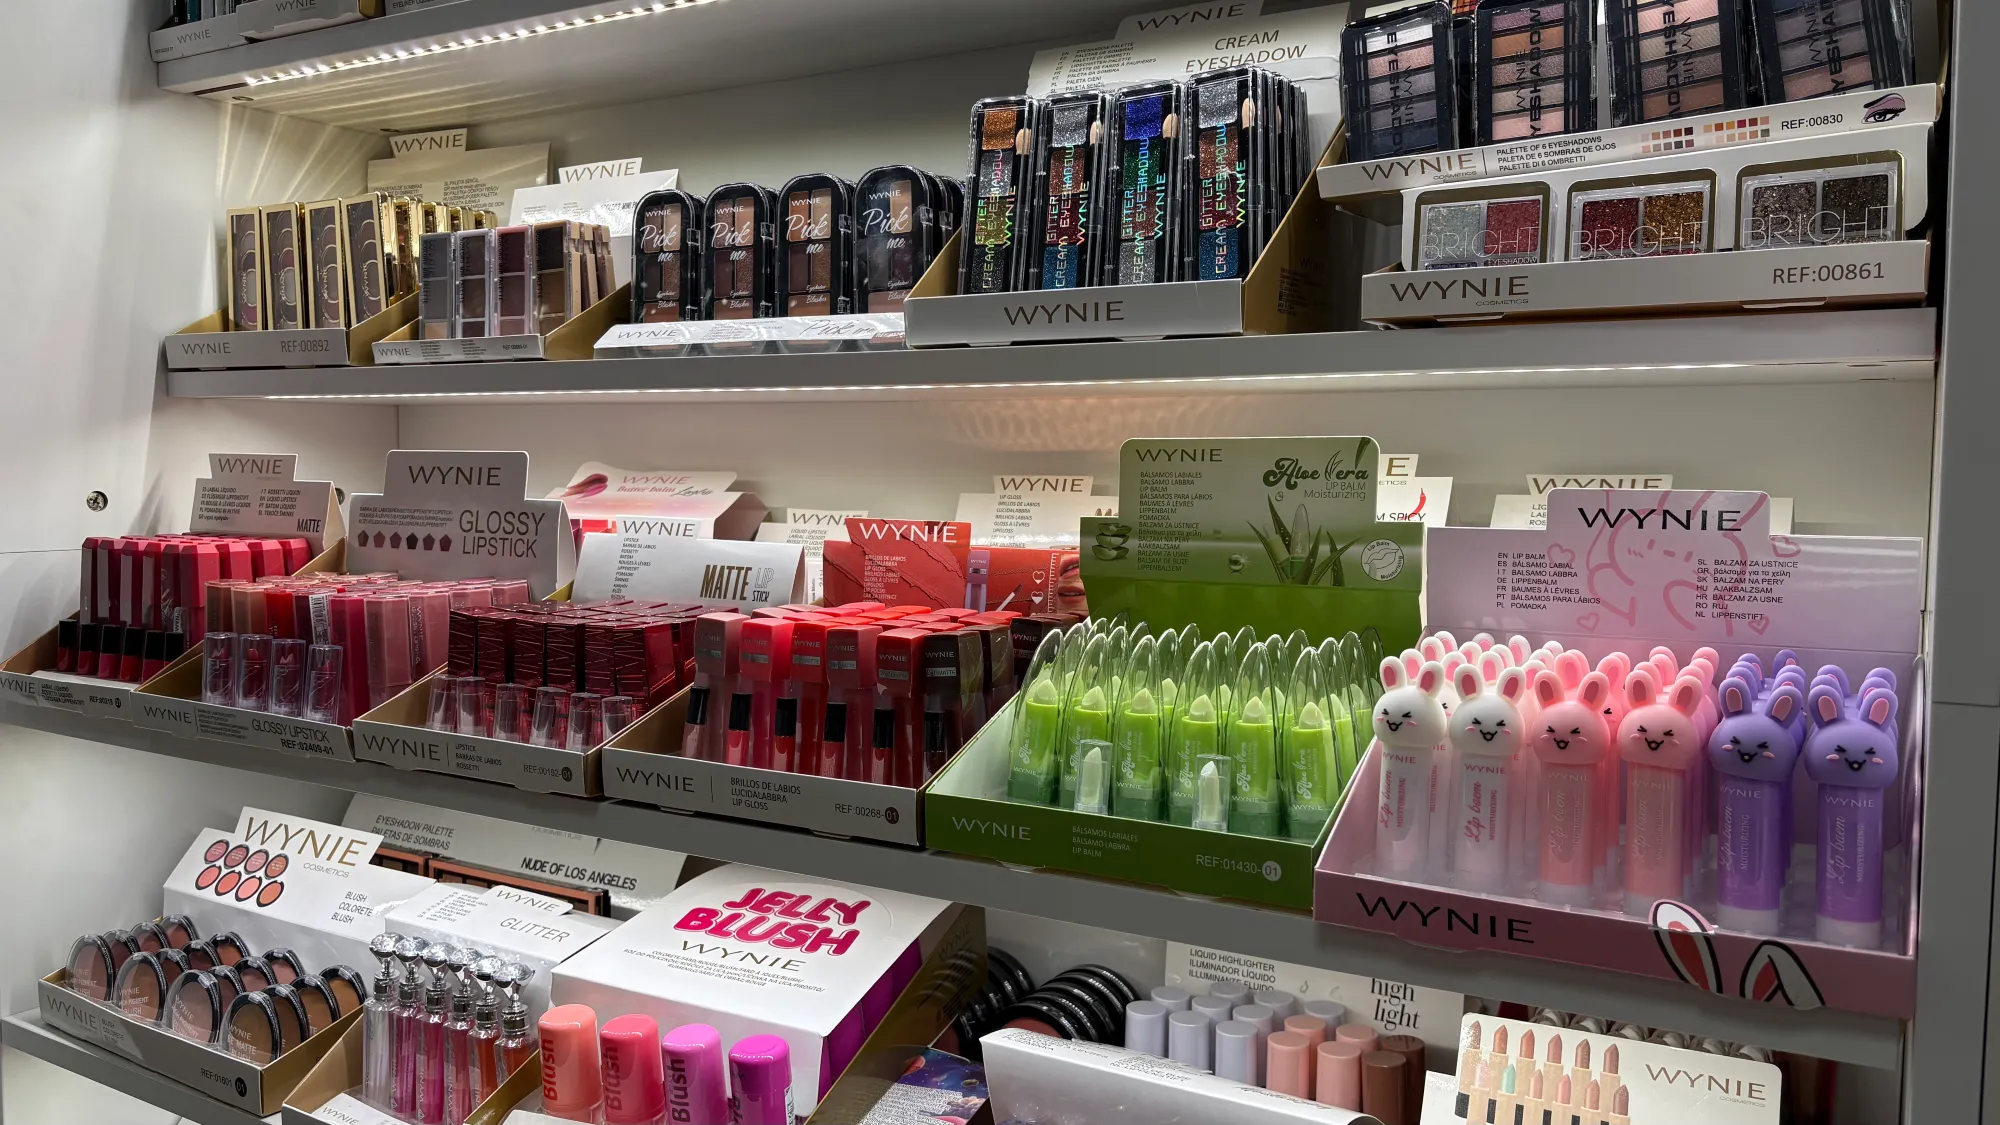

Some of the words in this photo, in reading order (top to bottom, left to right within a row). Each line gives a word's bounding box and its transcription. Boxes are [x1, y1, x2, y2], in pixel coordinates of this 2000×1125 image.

[1137, 3, 1246, 31] WYNIE
[177, 29, 211, 44] WYNIE
[1214, 30, 1280, 51] CREAM
[1185, 45, 1307, 74] EYESHADOW
[1516, 49, 1527, 111] WYNIE
[1781, 114, 1843, 130] REF:00830
[394, 133, 464, 153] WYNIE
[1496, 146, 1529, 155] PALETTE
[1530, 144, 1540, 152] OF
[1548, 136, 1602, 149] EYESHADOWS
[1497, 154, 1524, 163] PALETA
[1526, 152, 1536, 161] DE
[1544, 147, 1581, 158] SOMBRAS
[1583, 146, 1594, 154] DE
[1595, 142, 1617, 152] OJOS
[565, 161, 637, 183] WYNIE
[1216, 122, 1227, 211] EYESHADOW
[1361, 153, 1476, 180] WYNIE
[1499, 162, 1531, 172] PALETTE
[1532, 160, 1540, 168] DI
[1547, 156, 1586, 166] OMBRETTI
[988, 150, 1003, 230] EYESHADOW
[1060, 144, 1075, 228] EYESHADOW
[1136, 137, 1149, 222] EYESHADOW
[791, 197, 821, 206] WYNIE
[869, 189, 901, 200] WYNIE
[1236, 159, 1246, 228] WYNIE
[645, 209, 672, 217] WYNIE
[716, 206, 745, 215] WYNIE
[1003, 185, 1016, 249] WYNIE
[1076, 181, 1089, 246] WYNIE
[1154, 173, 1166, 239] WYNIE
[785, 213, 827, 240] Pick
[863, 206, 909, 236] Pick
[1742, 205, 1895, 248] BRIGHT
[640, 224, 677, 249] Pick
[710, 221, 751, 248] Pick
[886, 237, 906, 249] me
[1421, 227, 1539, 261] BRIGHT
[1571, 221, 1707, 260] BRIGHT
[657, 252, 674, 262] me
[729, 251, 747, 261] me
[806, 243, 824, 254] me
[1133, 231, 1145, 283] CREAM
[1215, 219, 1227, 274] CREAM
[982, 239, 995, 289] CREAM
[1055, 236, 1068, 287] CREAM
[1773, 262, 1885, 284] REF:00861
[1390, 276, 1529, 301] WYNIE
[1004, 301, 1124, 326] WYNIE
[618, 329, 679, 340] WYNIE
[182, 342, 231, 355] WYNIE
[280, 340, 329, 353] REF:00892
[378, 347, 411, 357] WYNIE
[218, 458, 283, 474] WYNIE
[1136, 448, 1222, 462] WYNIE
[409, 465, 501, 486] WYNIE
[623, 475, 692, 485] WYNIE
[1262, 457, 1320, 491] Aloe
[1324, 450, 1369, 481] Vera
[1000, 477, 1084, 492] WYNIE
[1303, 489, 1366, 502] Moisturizing
[1326, 482, 1338, 491] LIP
[1340, 482, 1366, 491] BALM
[297, 518, 321, 533] MATTE
[459, 510, 546, 537] GLOSSY
[623, 520, 696, 537] WYNIE
[1578, 506, 1742, 532] WYNIE
[859, 522, 957, 543] WYNIE
[462, 536, 537, 559] LIPSTICK
[1512, 560, 1548, 569] BÁLSAMO
[1714, 559, 1747, 567] BALZAM
[1761, 561, 1799, 569] USTNICE
[700, 564, 753, 601] MATTE
[755, 567, 775, 589] LIP
[1511, 578, 1558, 586] LIPPENBALM
[1713, 586, 1773, 594] AJAKBALZSAM
[752, 589, 770, 603] STICK
[1511, 594, 1551, 602] BÁLSAMOS
[1573, 596, 1601, 604] LÁBIOS
[1747, 595, 1759, 603] ZA
[1760, 596, 1784, 604] USNE
[1711, 612, 1764, 620] LIPPENSTIFT
[794, 639, 820, 648] WYNIE
[879, 654, 908, 662] WYNIE
[143, 704, 192, 724] WYNIE
[251, 718, 286, 738] GLOSSY
[287, 724, 330, 744] LIPSTICK
[362, 733, 441, 762] WYNIE
[455, 743, 477, 752] LIPSTICK
[456, 762, 480, 772] ROSSETTI
[1464, 762, 1506, 775] WYNIE
[616, 766, 696, 793] WYNIE
[730, 777, 760, 790] BRILLOS
[761, 781, 772, 790] DE
[773, 781, 801, 794] LABIOS
[731, 787, 788, 803] LUCIDALABBRA
[1232, 795, 1260, 804] WYNIE
[1720, 785, 1762, 799] WYNIE
[1825, 795, 1875, 808] WYNIE
[732, 799, 743, 807] LIP
[744, 800, 769, 811] GLOSS
[1489, 789, 1498, 841] MOISTURIZING
[376, 814, 423, 831] EYESHADOW
[421, 823, 455, 838] PALETTE
[952, 816, 1031, 841] WYNIE
[244, 816, 368, 867] WYNIE
[371, 826, 402, 841] PALETAS
[401, 833, 414, 843] DE
[413, 835, 451, 851] SOMBRAS
[1072, 836, 1104, 848] BALSAMO
[1105, 842, 1131, 852] LABBRA
[1740, 814, 1750, 871] MOISTURIZING
[1856, 824, 1865, 883] MOISTURIZING
[302, 861, 350, 878] COSMETICS
[521, 857, 548, 874] NUDE
[549, 861, 563, 876] OF
[564, 864, 587, 881] LOS
[589, 868, 638, 892] ANGELES
[1196, 853, 1282, 882] REF:01430-01
[344, 890, 367, 903] BLUSH
[497, 889, 560, 913] WYNIE
[723, 887, 871, 926] JELLY
[331, 912, 354, 924] BLUSH
[338, 901, 374, 917] COLORETE
[1355, 892, 1536, 944] WYNIE
[500, 917, 571, 943] GLITTER
[673, 907, 860, 957] BLUSH
[682, 940, 807, 972] WYNIE
[1190, 948, 1217, 961] LIQUID
[1218, 954, 1275, 973] HIGHLIGHTER
[1189, 958, 1240, 977] ILUMINADOR
[1241, 968, 1276, 983] LÍQUIDO
[1370, 977, 1415, 1005] high
[46, 994, 97, 1028] WYNIE
[1374, 1000, 1421, 1031] light
[542, 1037, 559, 1101] Blush
[602, 1046, 623, 1111] Blush
[670, 1058, 691, 1123] Blush
[1644, 1063, 1767, 1101] WYNIE
[322, 1106, 359, 1125] WYNIE
